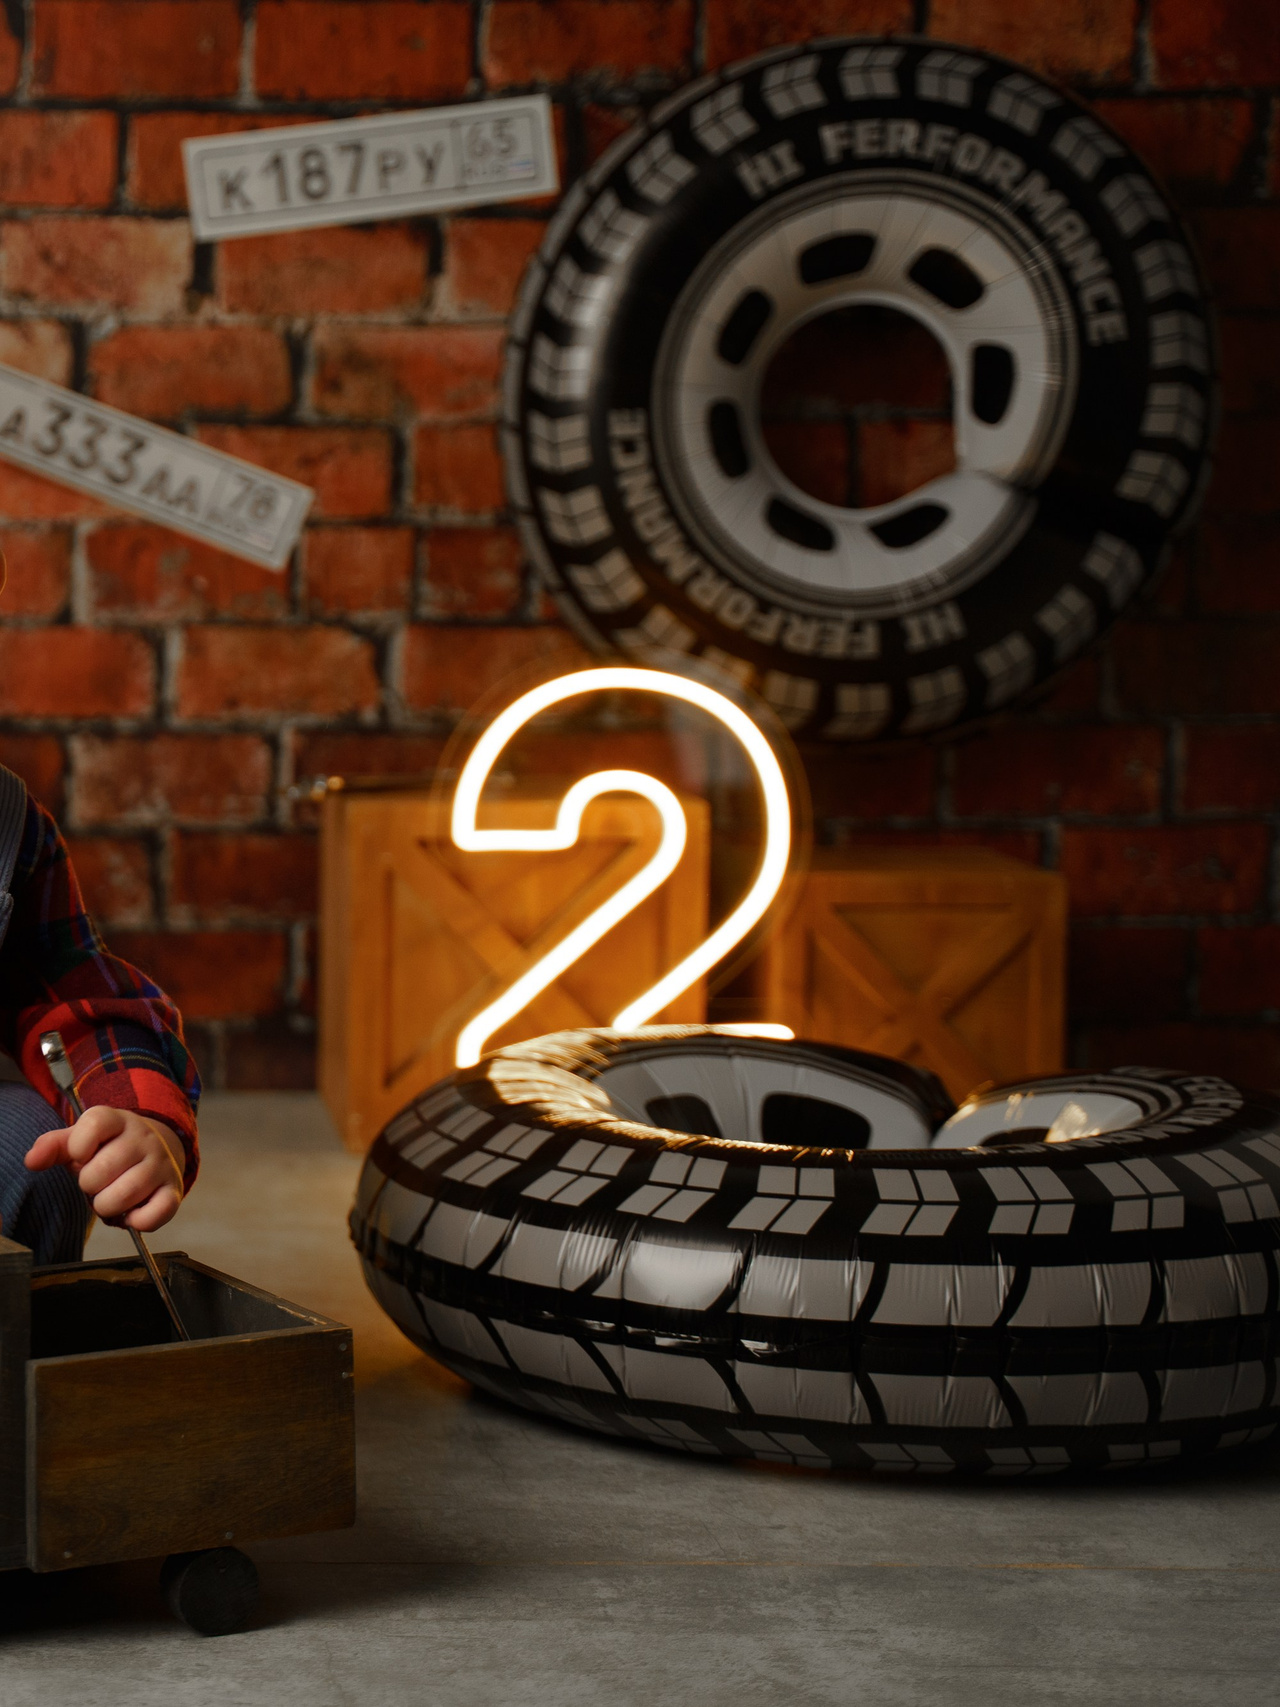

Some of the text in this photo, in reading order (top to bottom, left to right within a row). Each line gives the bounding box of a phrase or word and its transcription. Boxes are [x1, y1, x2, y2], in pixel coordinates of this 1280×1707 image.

[735, 139, 805, 198] HI
[902, 601, 967, 650] HI
[452, 667, 795, 1068] 2
